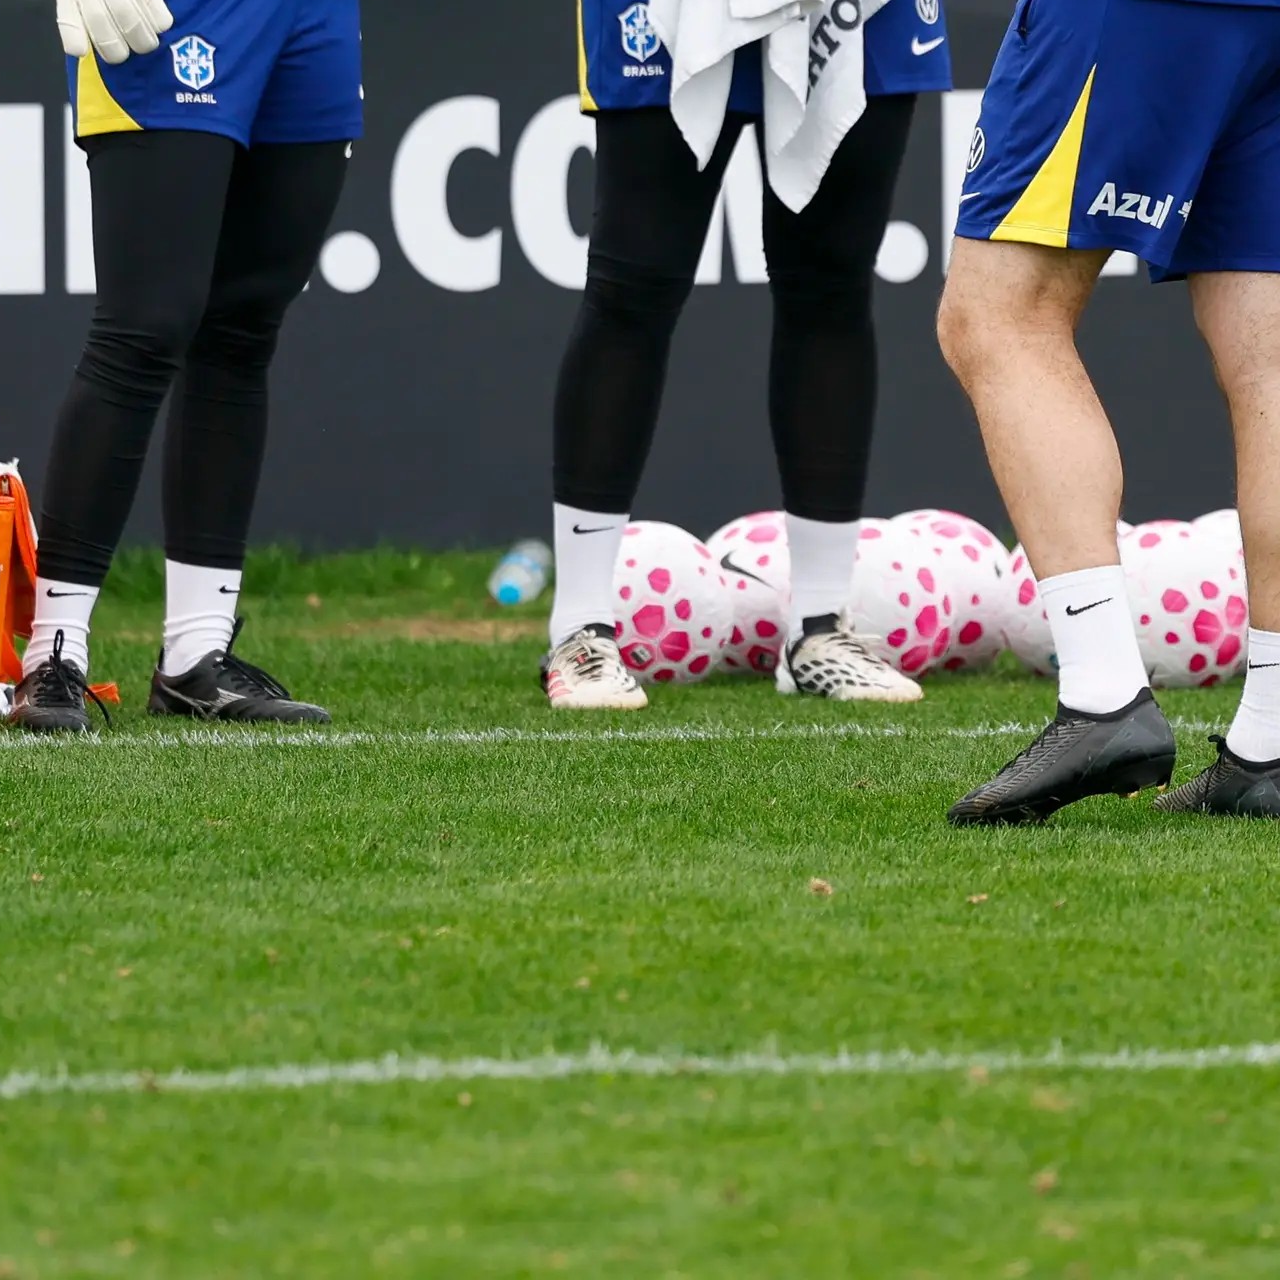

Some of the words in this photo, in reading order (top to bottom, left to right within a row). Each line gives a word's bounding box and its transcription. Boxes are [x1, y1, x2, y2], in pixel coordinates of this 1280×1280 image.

[623, 64, 665, 78] BRASIL
[175, 92, 217, 105] BRASIL
[1086, 181, 1175, 230] Azul
